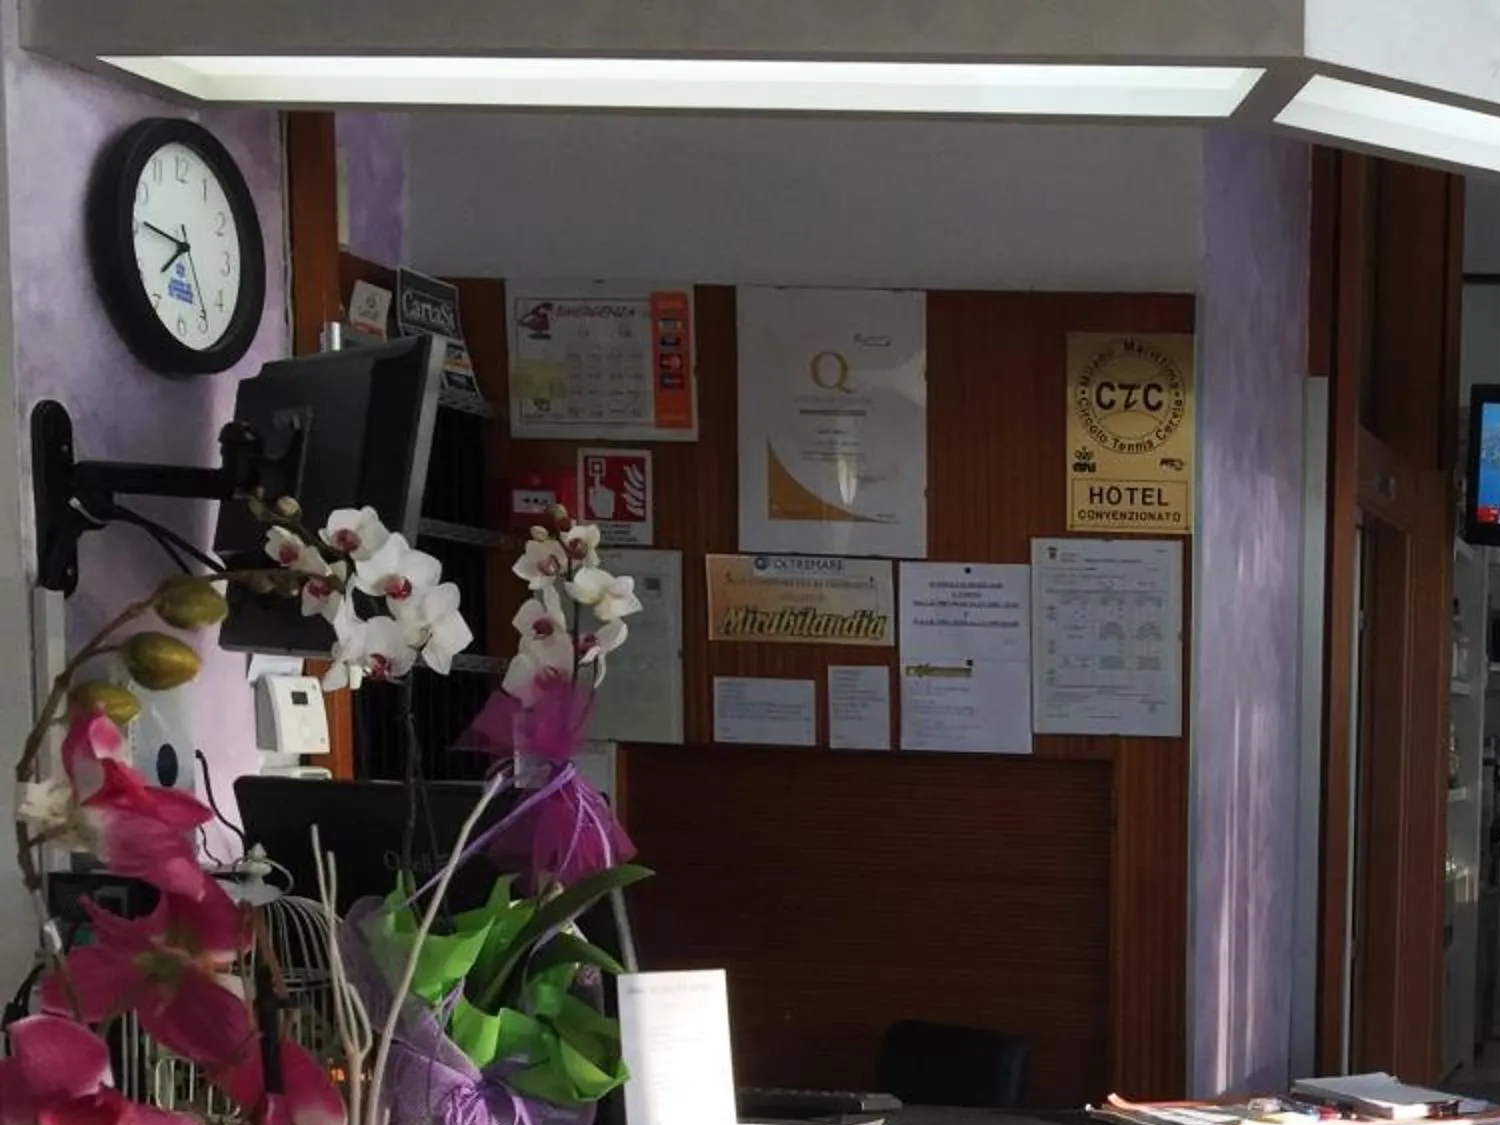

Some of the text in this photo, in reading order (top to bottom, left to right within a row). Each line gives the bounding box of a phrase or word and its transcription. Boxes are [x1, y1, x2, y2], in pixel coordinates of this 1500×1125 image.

[175, 155, 188, 183] 12
[215, 210, 226, 237] 2
[221, 250, 231, 277] 3
[214, 288, 224, 312] 4
[177, 314, 187, 337] 6
[811, 350, 853, 395] Q
[1112, 437, 1155, 453] Tennis
[1089, 485, 1170, 507] HOTEL
[1077, 508, 1182, 522] CONVENZIONATO
